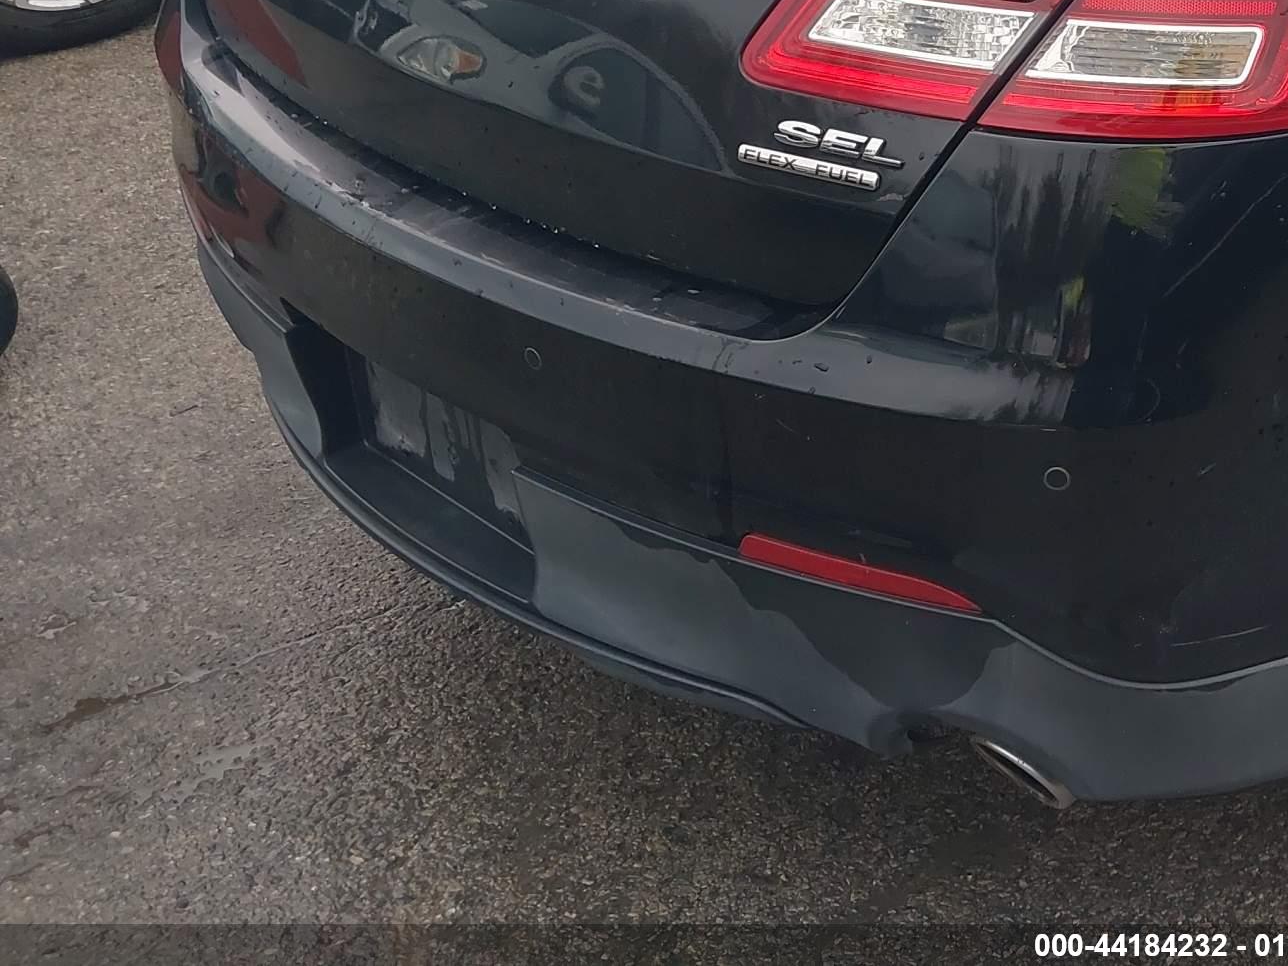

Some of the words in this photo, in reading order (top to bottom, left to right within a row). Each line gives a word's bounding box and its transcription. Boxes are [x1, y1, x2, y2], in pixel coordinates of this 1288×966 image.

[773, 119, 904, 169] SEL
[742, 147, 798, 172] FLEX
[814, 163, 874, 188] FUEL
